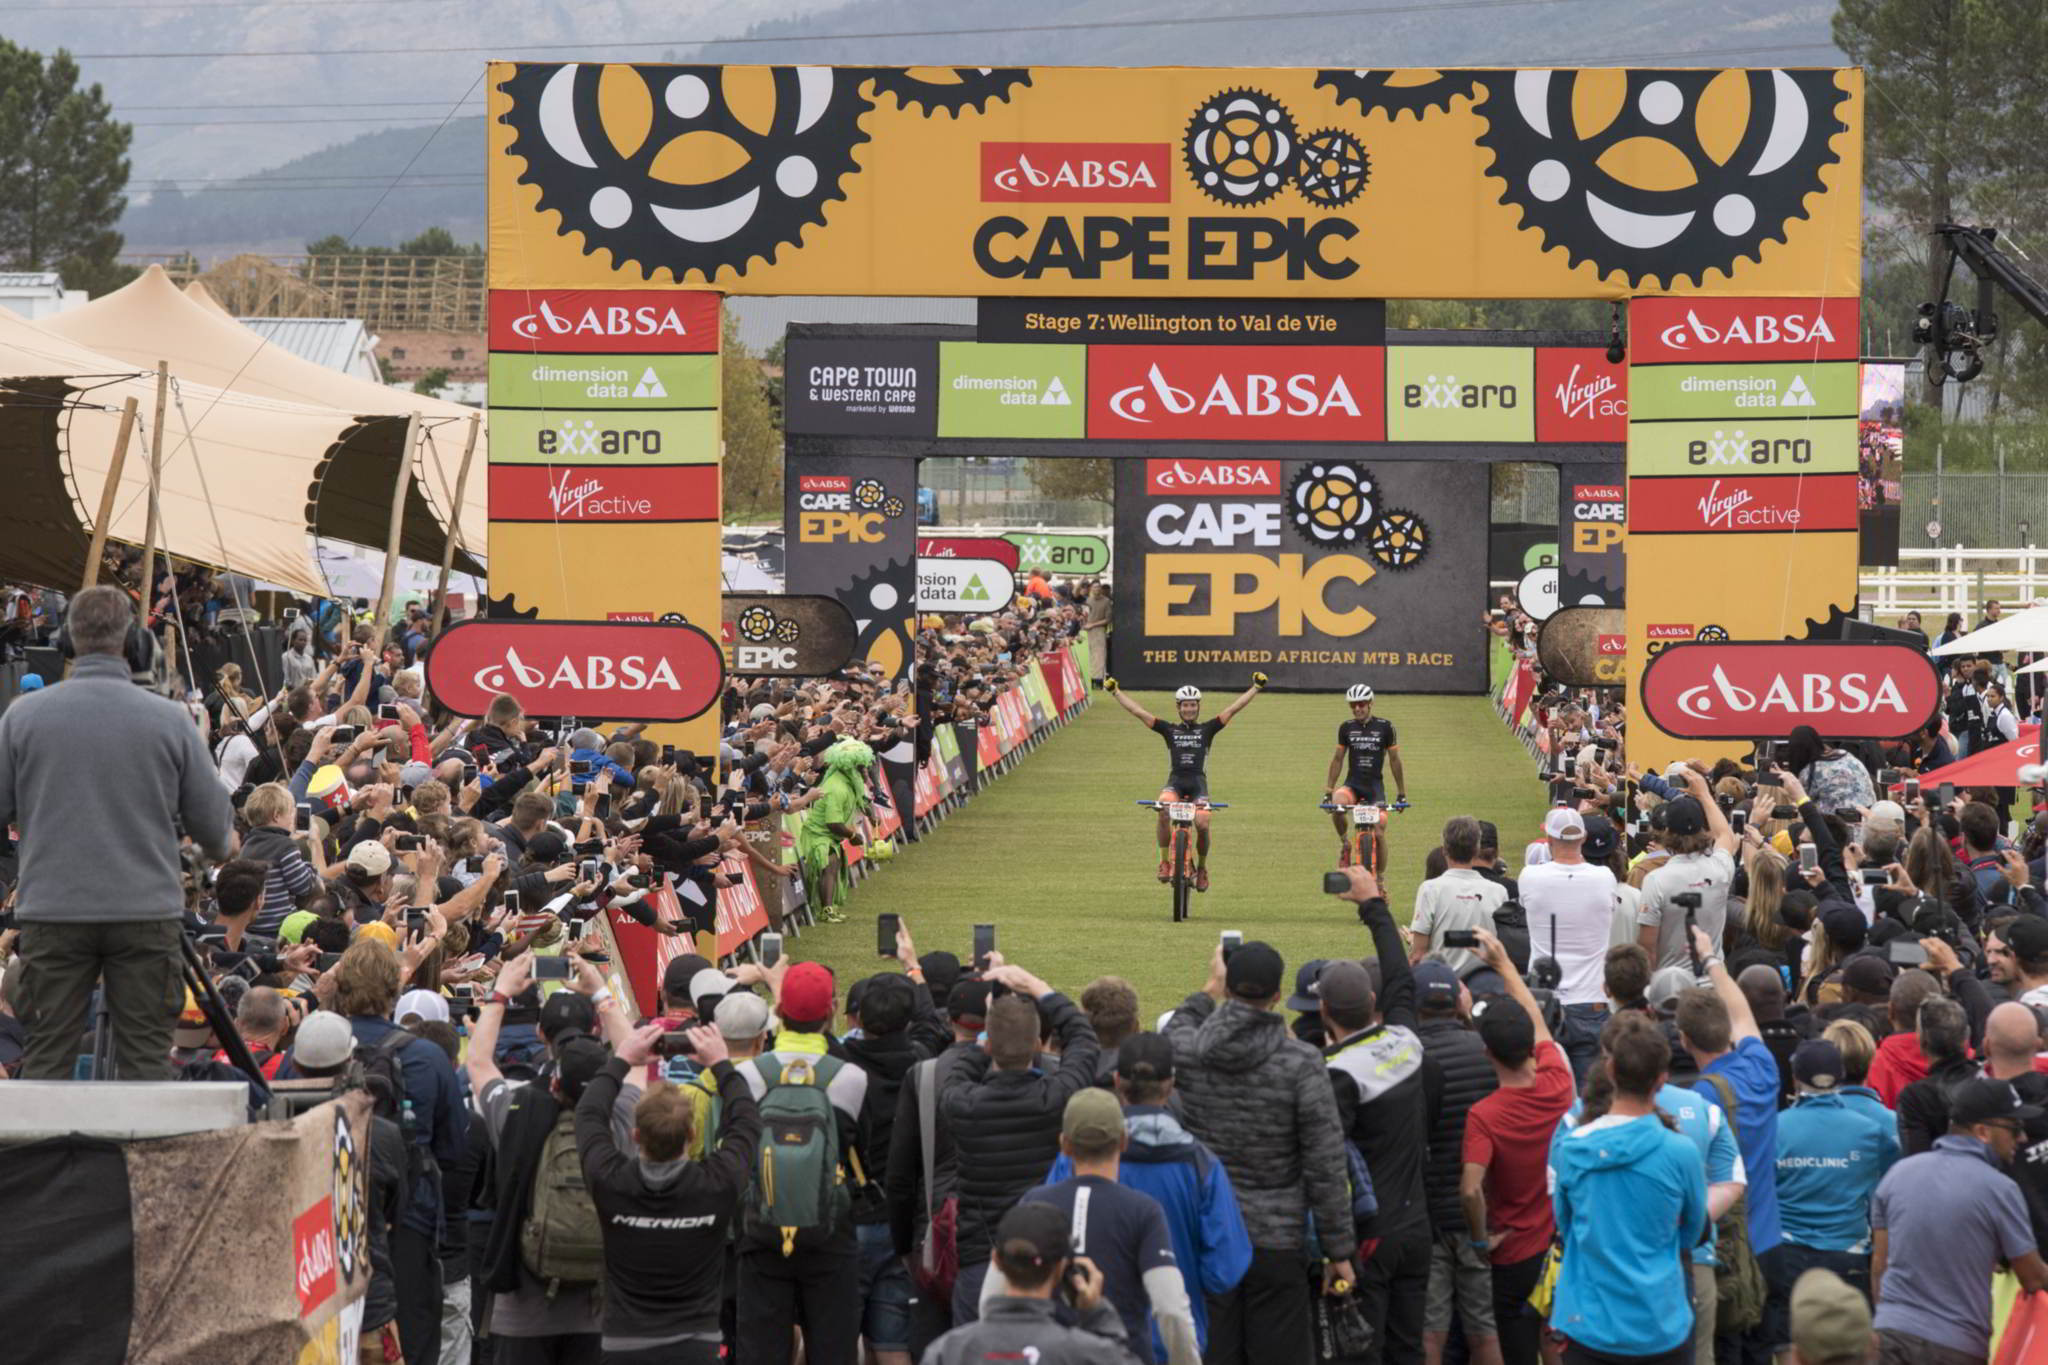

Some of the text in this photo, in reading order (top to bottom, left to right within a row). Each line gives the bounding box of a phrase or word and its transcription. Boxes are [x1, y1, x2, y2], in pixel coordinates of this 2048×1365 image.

[1052, 160, 1157, 188] ABSA
[973, 216, 1361, 280] CAPE EPIC
[574, 306, 687, 336] ABSA
[1025, 313, 1081, 333] Stage
[1217, 315, 1237, 331] to
[1240, 314, 1271, 331] Val
[1277, 314, 1301, 331] de
[1306, 314, 1337, 331] Vie
[1723, 315, 1836, 344] ABSA
[532, 366, 629, 382] dimension
[953, 375, 1038, 390] dimension
[587, 383, 629, 398] data
[1403, 375, 1517, 410] exxaro
[1555, 364, 1617, 419] Virgin
[1680, 376, 1777, 392] dimension
[809, 388, 819, 401] &
[1000, 390, 1038, 405] data
[1199, 373, 1362, 417] ABSA
[1735, 392, 1777, 407] data
[845, 405, 877, 413] marketed
[878, 405, 887, 414] by
[538, 419, 661, 455] exxaro
[1688, 429, 1811, 465] exxaro
[1195, 463, 1272, 486] ABSA
[549, 469, 604, 517] Virgin
[820, 480, 847, 489] ABSA
[1593, 489, 1621, 498] ABSA
[588, 496, 651, 514] active
[800, 493, 851, 510] CAPE
[1698, 480, 1752, 528] Virgin
[1574, 503, 1624, 520] CAPE
[1737, 505, 1801, 524] active
[800, 512, 886, 543] EPIC
[1145, 502, 1281, 547] CAPE
[1020, 536, 1095, 565] xxaro
[918, 572, 957, 586] nsion
[920, 587, 957, 601] data
[1144, 553, 1377, 637] EPIC
[1664, 627, 1691, 636] ABSA
[738, 646, 799, 670] EPIC
[1144, 650, 1454, 666] THE UNTAMED AFRICAN MTB RACE
[547, 655, 683, 691] ABSA
[1759, 672, 1909, 714] ABSA
[744, 831, 771, 842] EPIC
[1776, 1157, 1849, 1169] MEDICLINIC
[612, 1213, 716, 1229] MERIDA
